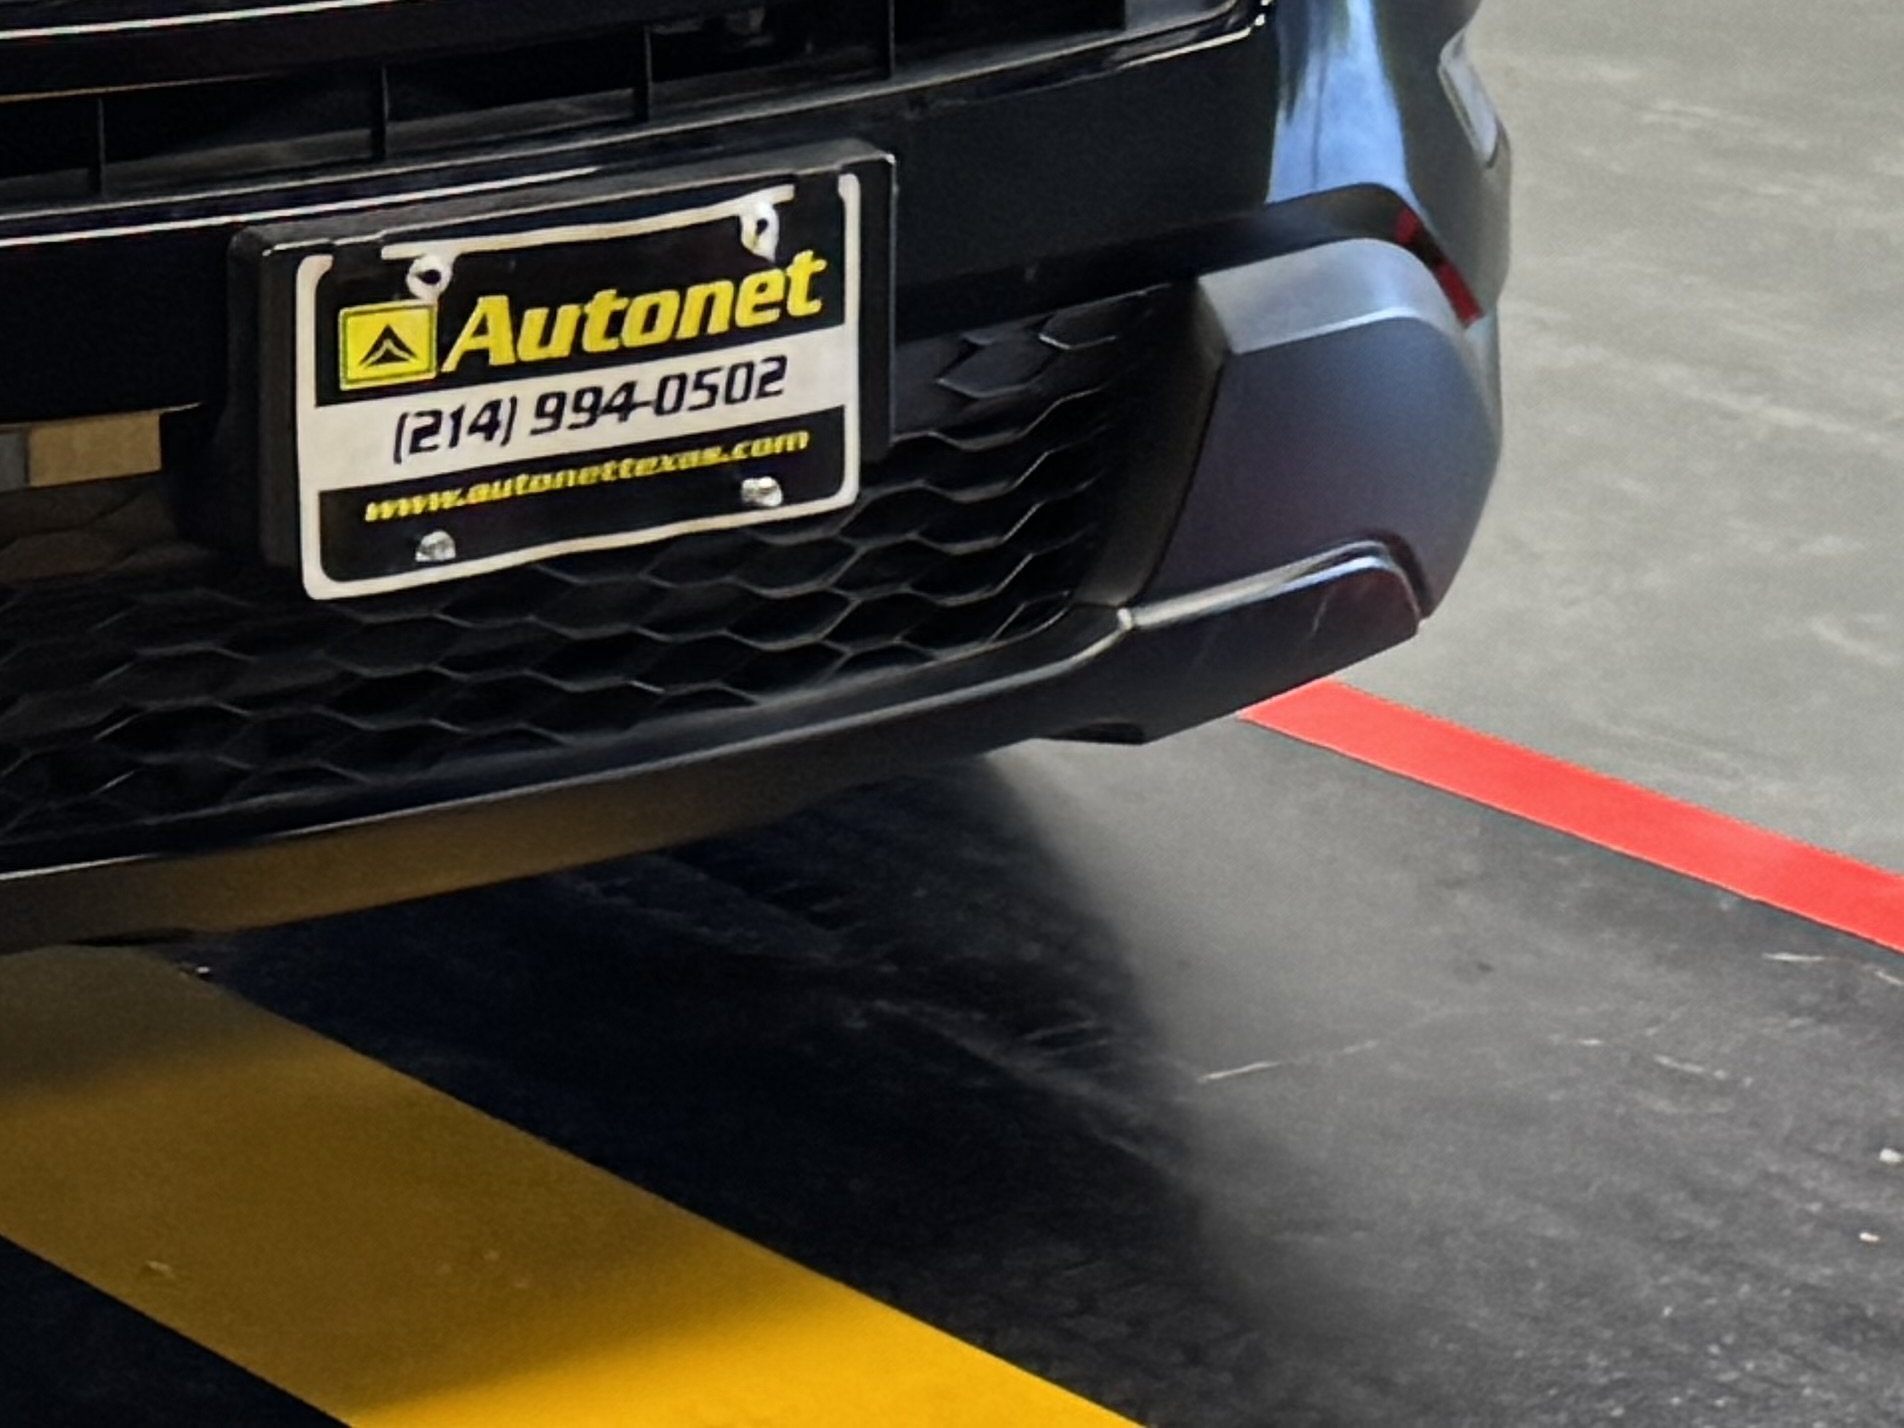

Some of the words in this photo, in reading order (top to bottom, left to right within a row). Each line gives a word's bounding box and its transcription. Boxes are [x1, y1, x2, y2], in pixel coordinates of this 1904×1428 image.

[439, 249, 829, 374] Autonet
[392, 395, 519, 465] (214)
[529, 354, 789, 437] 994-0502
[364, 429, 811, 523] www.autonettexas.com
